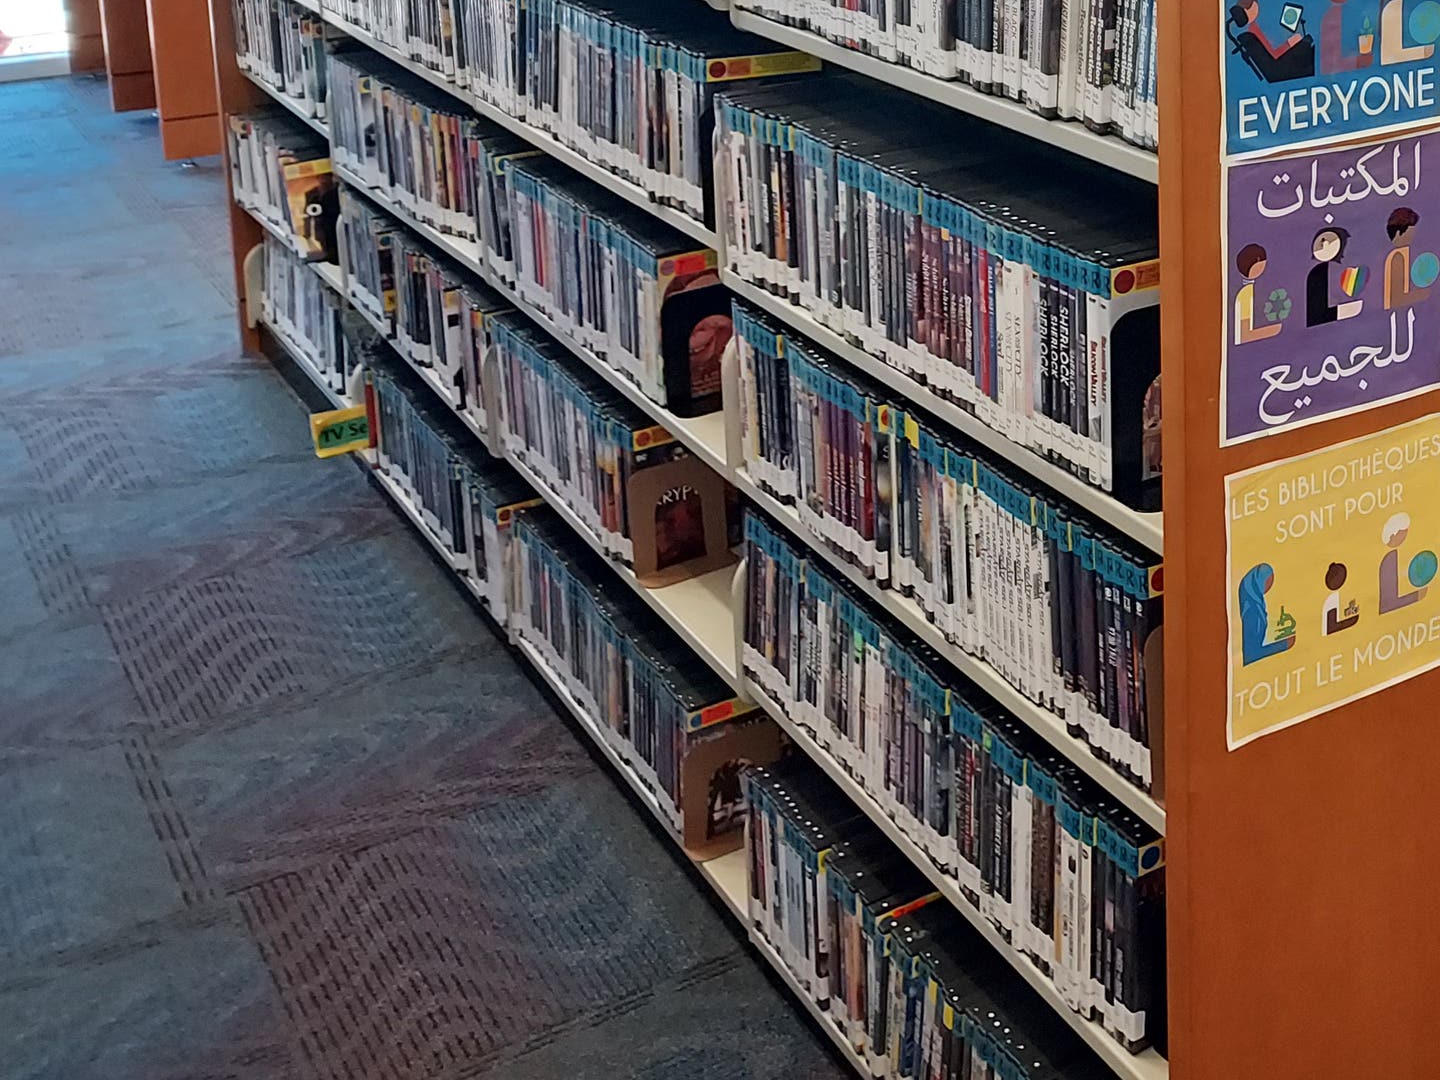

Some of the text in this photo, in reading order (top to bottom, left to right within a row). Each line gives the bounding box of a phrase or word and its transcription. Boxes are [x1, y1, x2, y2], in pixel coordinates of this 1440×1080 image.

[1238, 67, 1436, 140] EVERYONE
[1257, 140, 1422, 226] المكتبات
[1039, 298, 1049, 377] SHERLOCK
[1050, 314, 1058, 378] SHERLOCK
[1059, 304, 1069, 386] SHERLOCK
[1258, 307, 1416, 425] للجميع
[321, 425, 344, 443] TV
[1231, 484, 1270, 522] LES
[1274, 482, 1405, 544] SONT POUR
[1234, 667, 1306, 718] TOUT
[1315, 653, 1344, 689] LE
